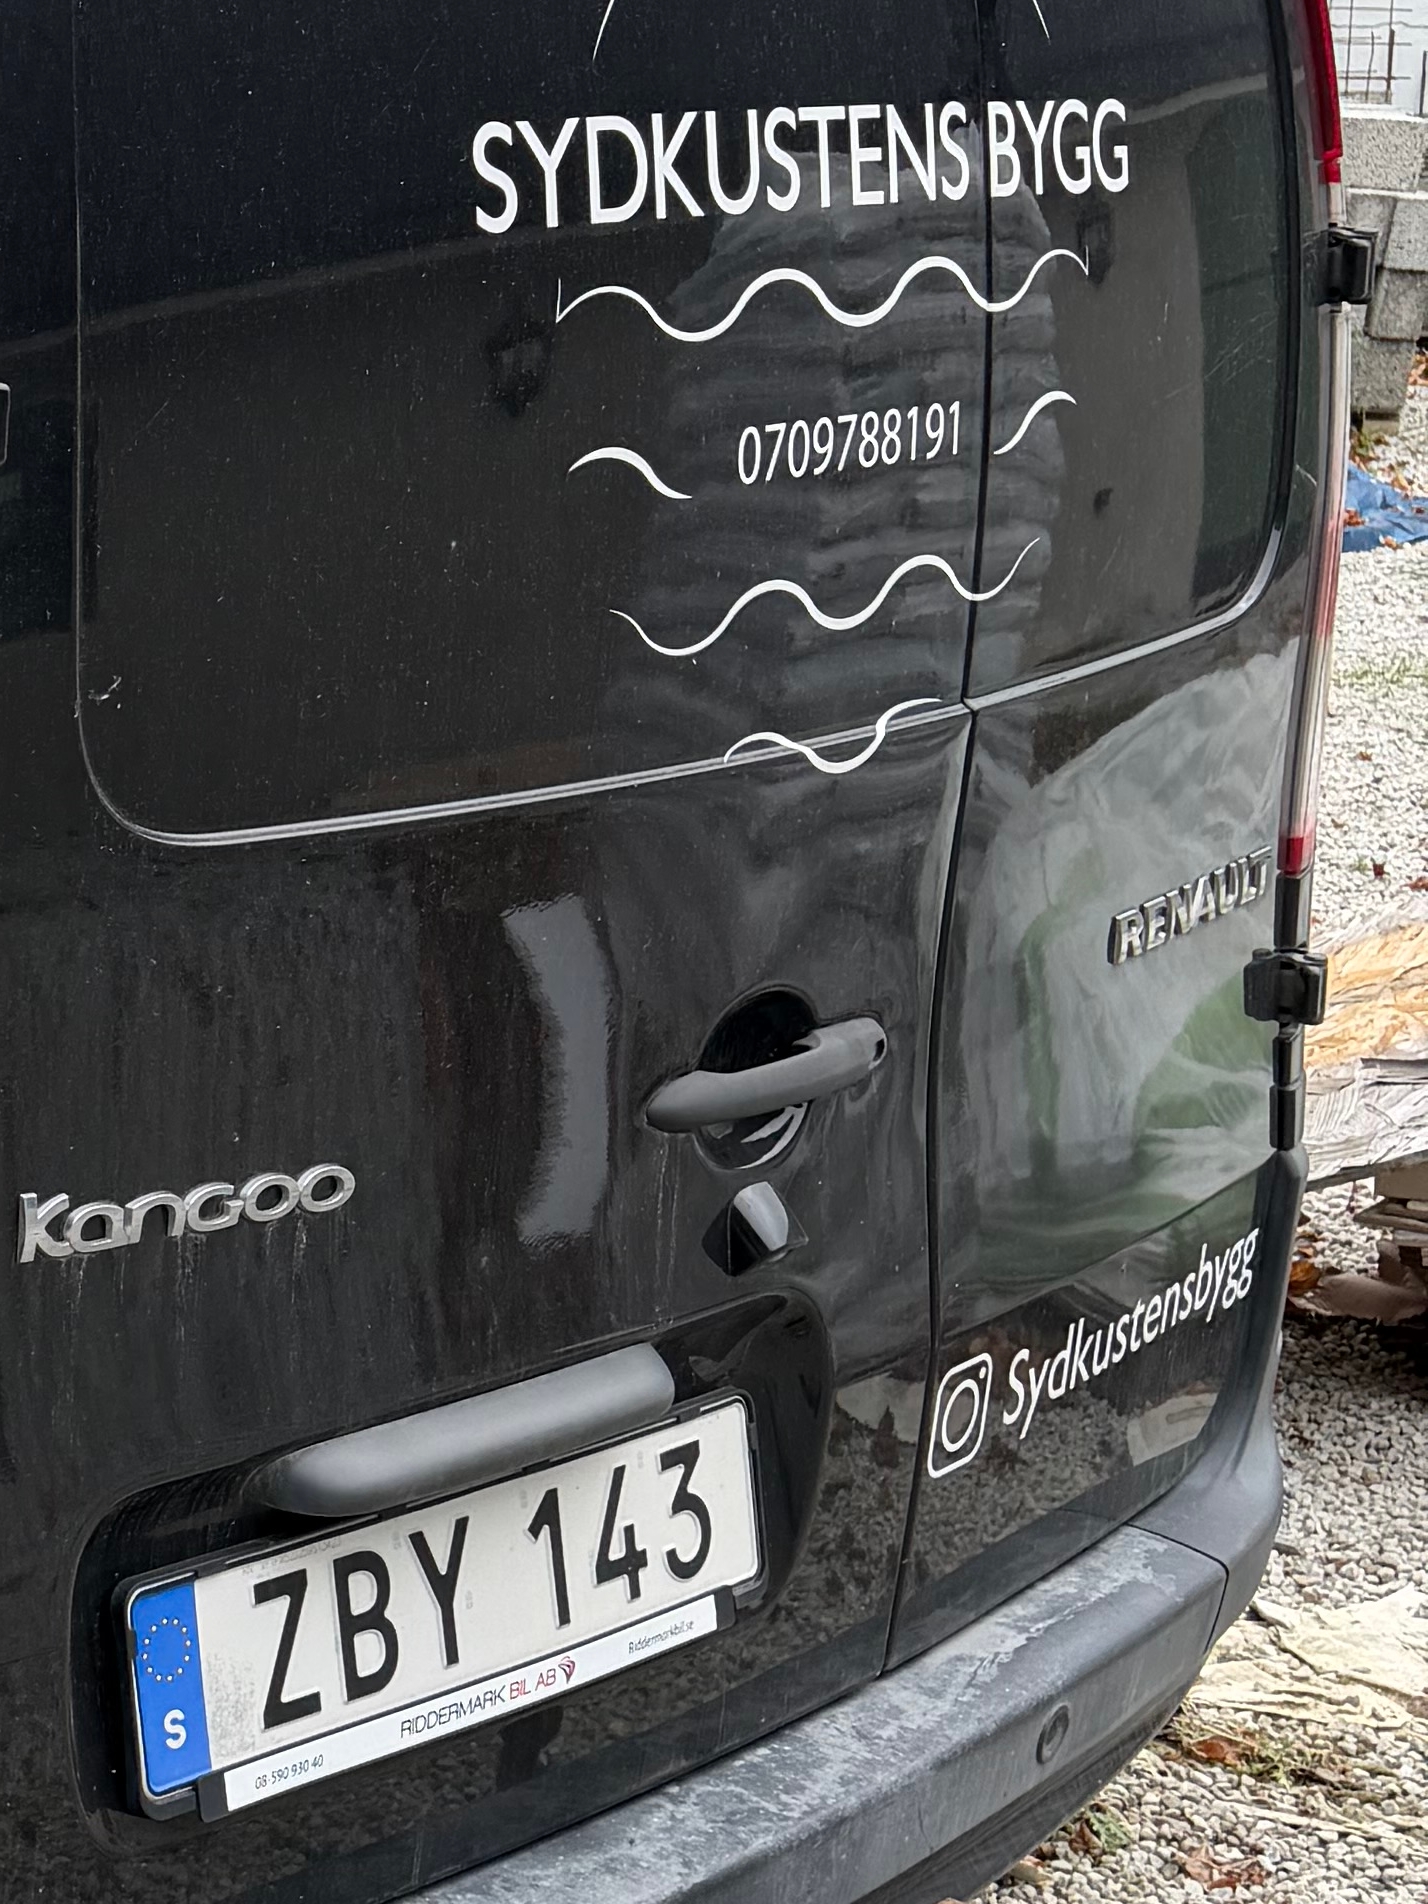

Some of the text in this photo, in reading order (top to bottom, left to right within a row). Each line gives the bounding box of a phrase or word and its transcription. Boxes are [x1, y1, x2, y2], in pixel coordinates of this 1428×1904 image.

[470, 97, 1131, 235] SYDKUSTENS BYGG
[736, 400, 963, 486] 0709788191
[1107, 845, 1273, 966] RENAULT
[1002, 1226, 1260, 1440] Sydkustensbygg
[252, 1439, 713, 1732] ZBY 143
[163, 1708, 188, 1750] S
[400, 1668, 557, 1738] RIDDERMARK BIL AB
[310, 1753, 324, 1769] 40
